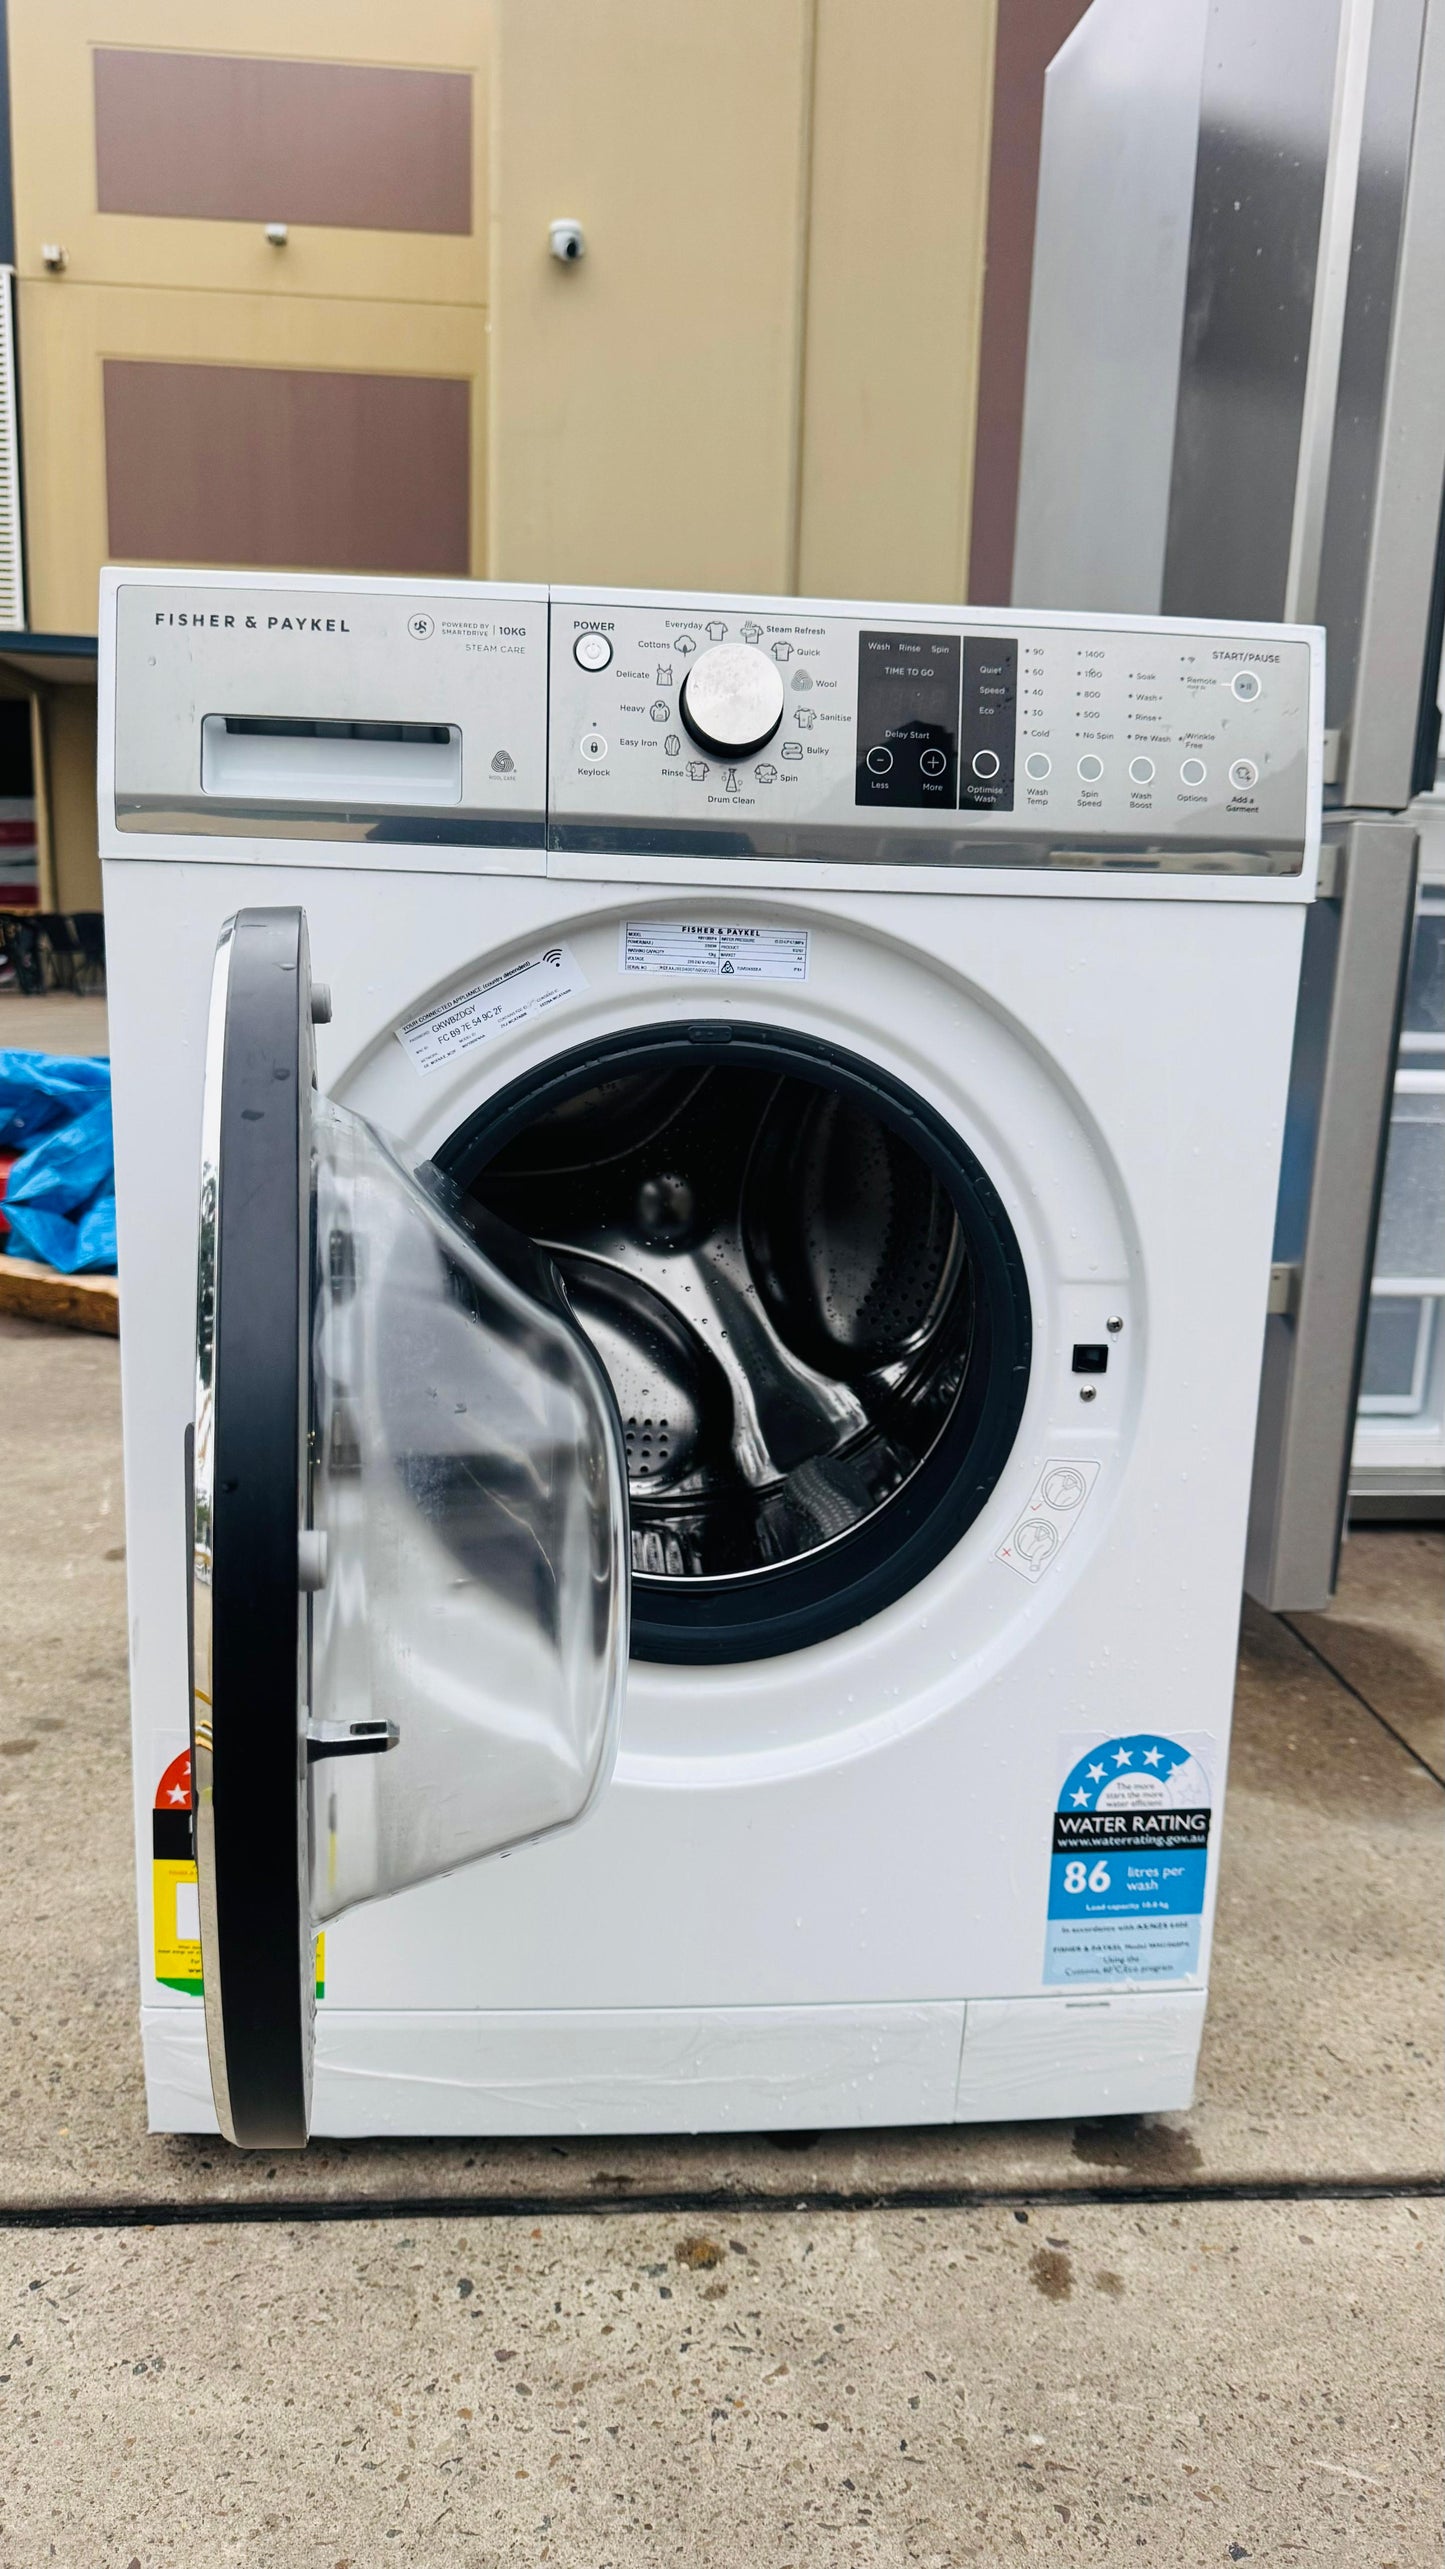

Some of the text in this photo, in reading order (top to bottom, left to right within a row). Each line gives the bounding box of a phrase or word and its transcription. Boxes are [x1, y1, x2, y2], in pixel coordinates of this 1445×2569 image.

[155, 613, 351, 633] FISHER & PAYKEL
[573, 621, 615, 631] POWER
[665, 621, 703, 631] Everyday
[499, 626, 526, 636] 10KG
[766, 625, 825, 635] Steam Refresh
[465, 644, 526, 654] STEAM CARE
[638, 640, 670, 649] Cottons
[868, 642, 949, 654] Wash Rinse Spin
[797, 648, 820, 657] Quick
[1032, 648, 1044, 656] 90
[1085, 650, 1105, 658] 1400
[1212, 651, 1281, 663] START/PAUSE
[616, 670, 650, 679] Delicate
[884, 667, 934, 677] TIME TO GO
[980, 666, 1002, 675] Quiet
[1136, 672, 1156, 680] Soak
[1186, 676, 1217, 685] Remote
[816, 680, 837, 688] Wool
[979, 687, 1005, 696] Speed
[1084, 691, 1101, 699] 800
[619, 704, 645, 714] Heavy
[979, 707, 994, 715] Eco
[820, 713, 852, 722] Sanitise
[1083, 711, 1100, 719] 500
[885, 730, 930, 740] Delay Start
[1031, 730, 1049, 738] Cold
[1083, 732, 1114, 741] No Spin
[1186, 732, 1215, 741] Wrinkle
[619, 738, 658, 748] Easy Iron
[1150, 735, 1171, 743] Wash
[806, 746, 830, 756] Bulky
[578, 768, 610, 777] Keylock
[661, 769, 684, 777] Rinse
[780, 774, 798, 783] Spin
[871, 782, 889, 790] Less
[923, 783, 943, 792] More
[967, 786, 1003, 795] Optimise
[1027, 788, 1048, 796] Wash
[1081, 790, 1098, 799] Spin
[1130, 792, 1152, 800] Wash
[707, 796, 755, 805] Drum Clean
[974, 795, 996, 803] Wash
[1027, 798, 1049, 807] Temp
[1177, 794, 1208, 803] Options
[1231, 796, 1247, 804] Add
[1077, 799, 1102, 808] Speed
[1130, 801, 1152, 809] Boost
[1226, 805, 1259, 814] Garment
[682, 926, 715, 935] FISHER
[727, 928, 760, 936] PAYKEL
[402, 959, 531, 1031] YOUR CONNECTED APPLIANCE (country dependent)
[430, 1003, 477, 1033] GKWBZDGY
[437, 1032, 450, 1044] FC
[448, 1026, 461, 1038] B9
[460, 1021, 472, 1032] 7E
[470, 1015, 482, 1026] 54
[480, 1009, 493, 1021] 9C
[492, 1004, 504, 1015] 2F
[1116, 1782, 1132, 1790] The
[1106, 1792, 1126, 1800] stars
[1127, 1791, 1141, 1799] the
[1059, 1813, 1207, 1834] WATER RATING
[1057, 1834, 1206, 1848] www.waterrating.gov.au
[1063, 1860, 1111, 1894] 86
[1127, 1866, 1185, 1880] litres per
[1126, 1879, 1159, 1892] wash
[1107, 1902, 1139, 1912] capacity
